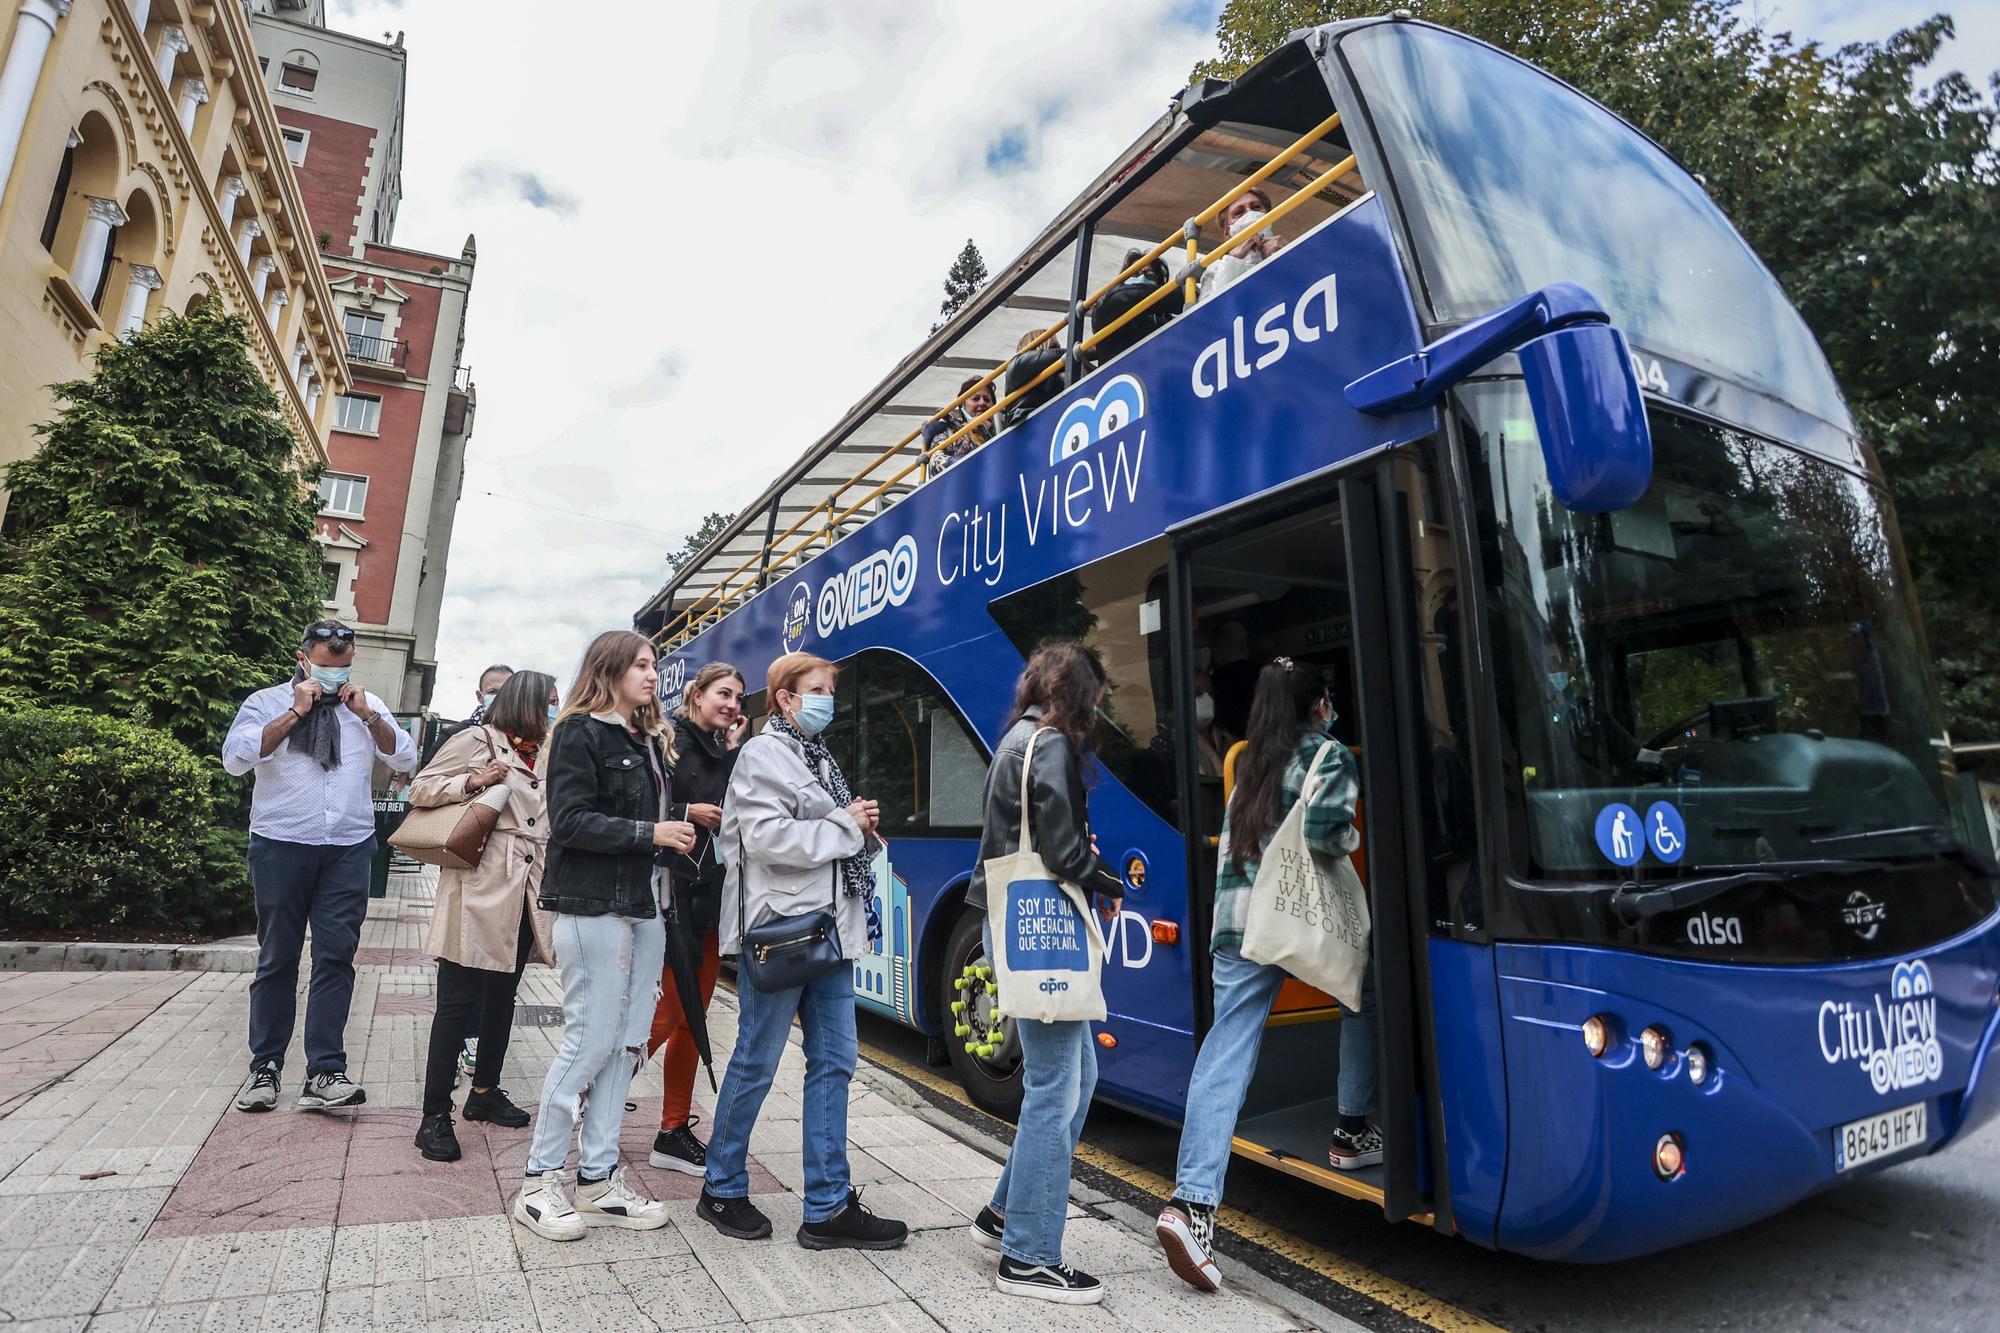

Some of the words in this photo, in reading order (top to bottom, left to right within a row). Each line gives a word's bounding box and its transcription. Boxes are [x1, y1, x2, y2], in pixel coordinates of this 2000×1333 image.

[1191, 273, 1339, 398] alsa
[816, 534, 919, 639] OVIEDO
[936, 503, 1006, 586] City
[1019, 429, 1148, 547] View
[655, 658, 685, 698] VIEDO
[387, 802, 404, 812] BIEN
[1280, 848, 1326, 887] WHT
[1017, 897, 1040, 916] SOY
[1044, 897, 1056, 916] DE
[1278, 880, 1332, 918] WHAT
[1018, 935, 1038, 951] QUE
[1040, 935, 1051, 951] SE
[1687, 911, 1743, 945] alsa
[1818, 1000, 1873, 1072] City
[1874, 993, 1937, 1052] View
[1869, 1037, 1943, 1095] OVIEDO
[1846, 1118, 1889, 1162] 8649
[1893, 1108, 1923, 1147] HFV
